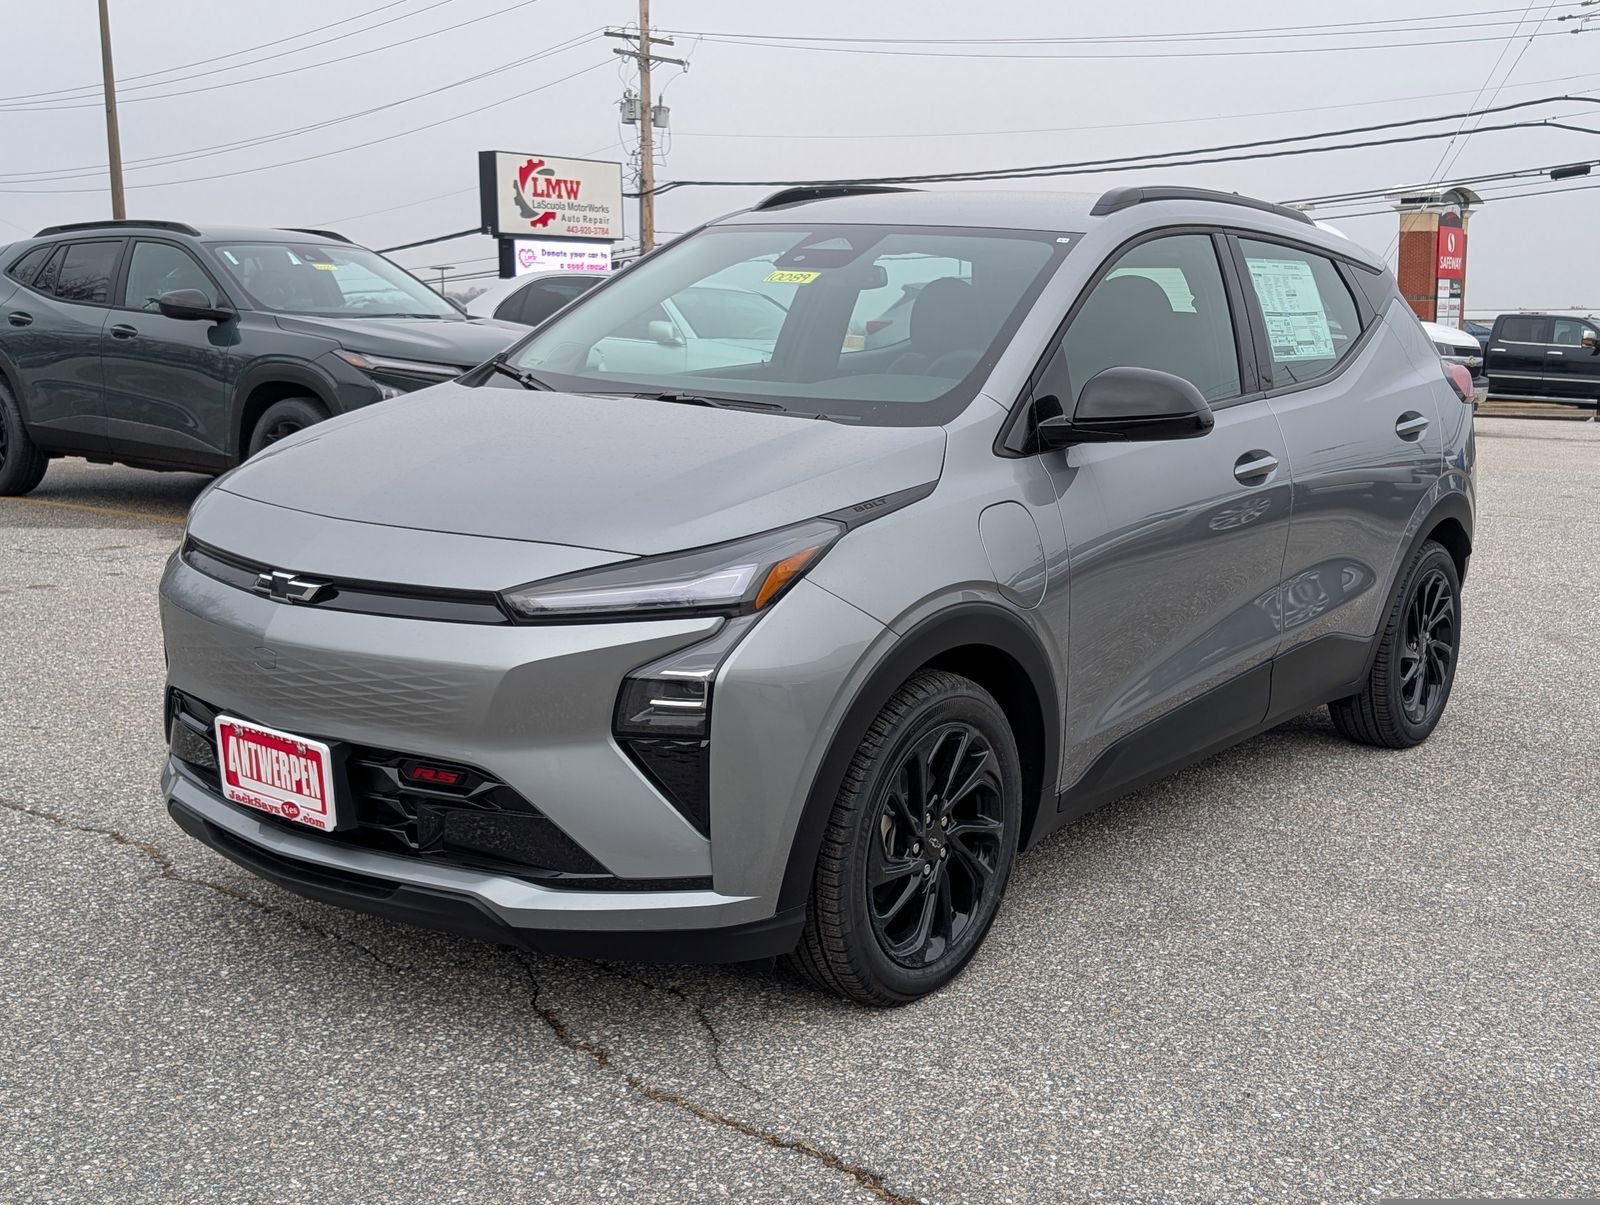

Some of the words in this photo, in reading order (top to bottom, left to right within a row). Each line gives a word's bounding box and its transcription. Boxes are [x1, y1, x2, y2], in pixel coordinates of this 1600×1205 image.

[531, 177, 581, 200] LMW
[532, 200, 566, 211] LaScuola
[567, 202, 609, 213] MotorWorks
[561, 214, 581, 223] Auto
[582, 215, 610, 226] Repair
[541, 248, 567, 257] Donate
[569, 251, 586, 260] your
[1440, 255, 1462, 270] SAFEWAY
[853, 498, 887, 512] BOLT
[228, 735, 321, 800] ANTWERPEN
[412, 767, 458, 784] RS
